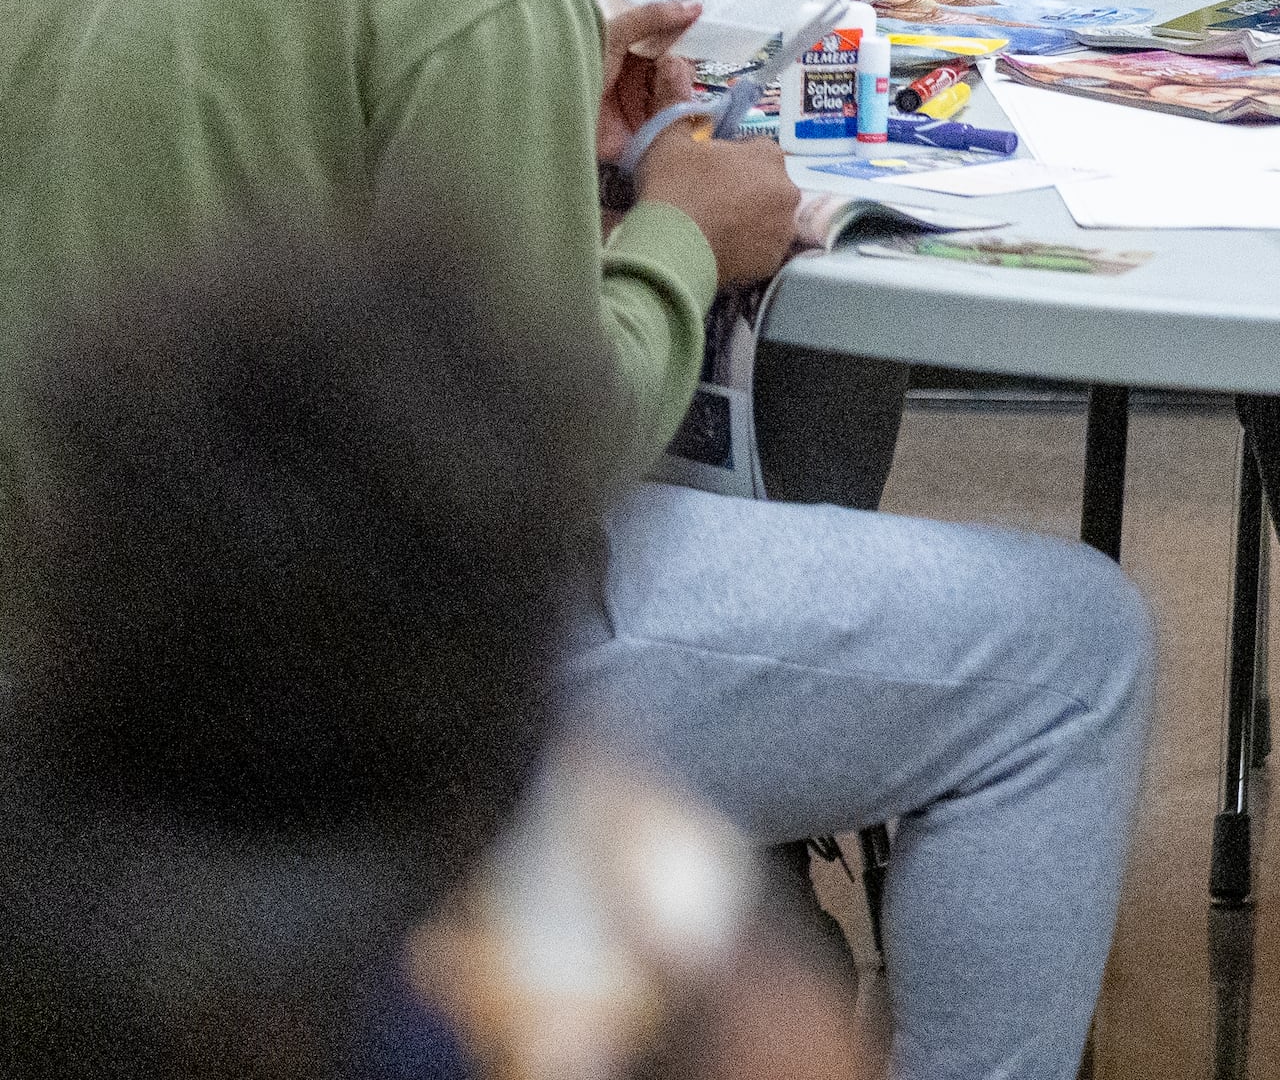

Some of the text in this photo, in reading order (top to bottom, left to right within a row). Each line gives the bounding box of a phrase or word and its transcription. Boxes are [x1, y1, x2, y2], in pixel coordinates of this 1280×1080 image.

[805, 52, 857, 64] ELMER'S
[807, 80, 853, 96] School
[812, 95, 843, 109] Glue
